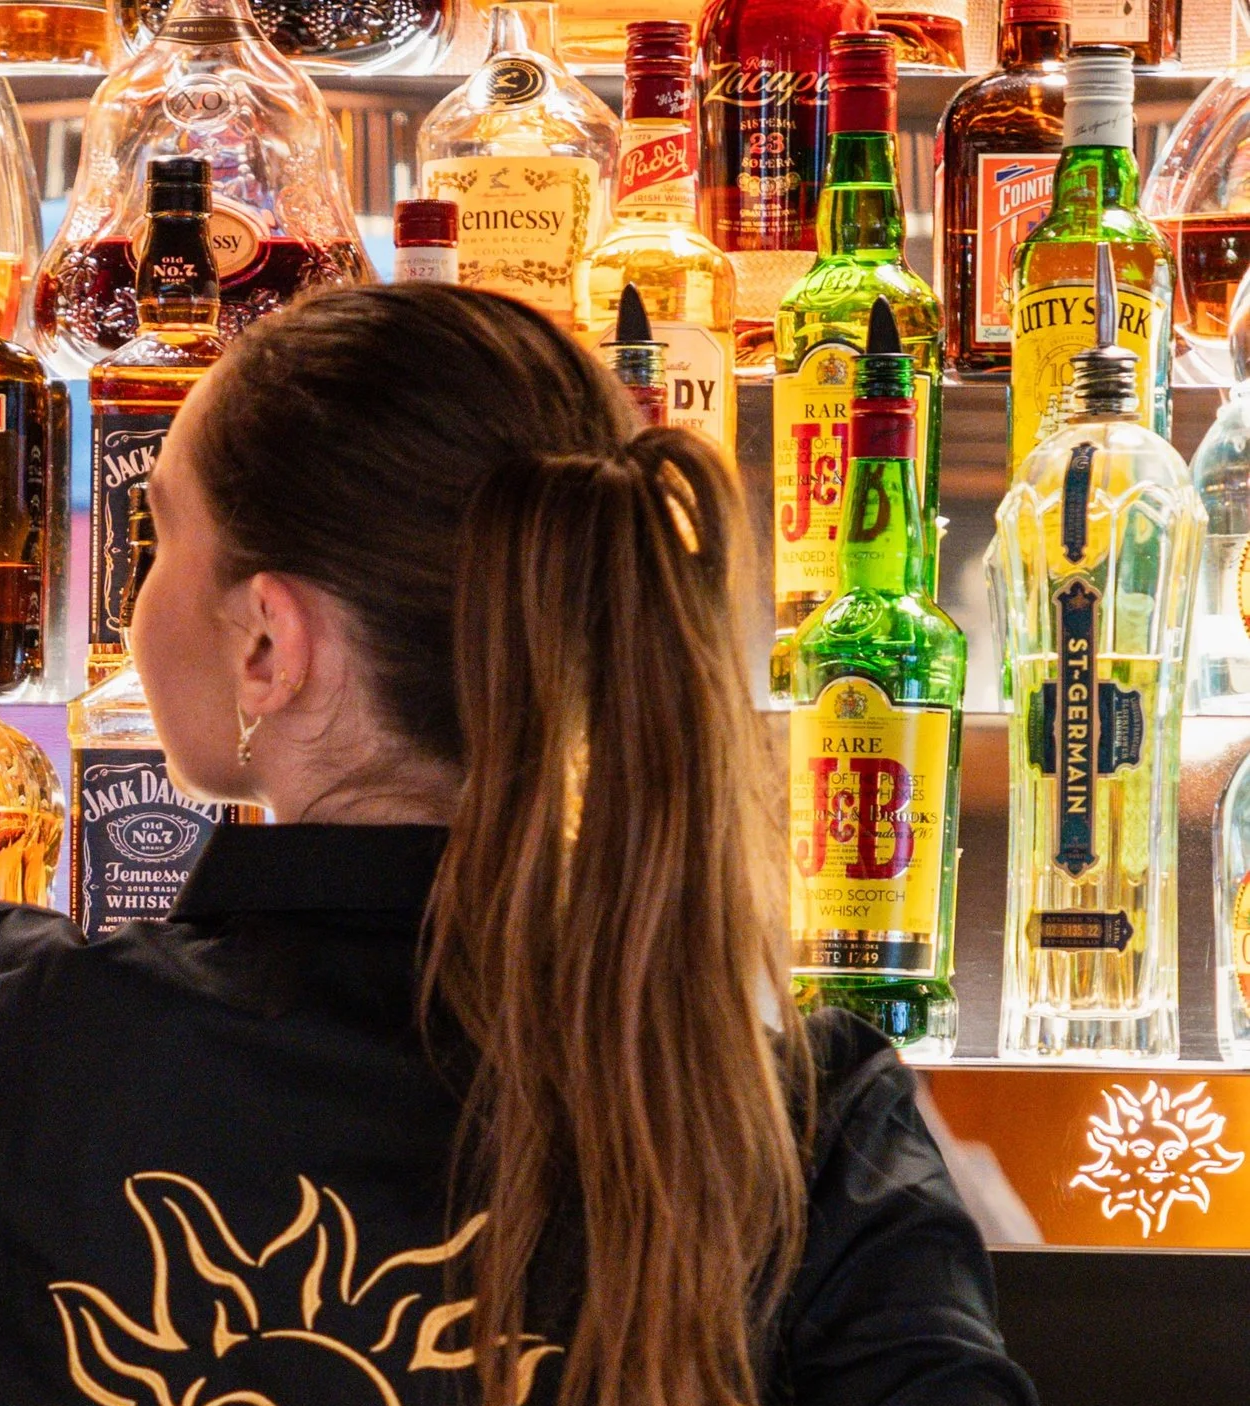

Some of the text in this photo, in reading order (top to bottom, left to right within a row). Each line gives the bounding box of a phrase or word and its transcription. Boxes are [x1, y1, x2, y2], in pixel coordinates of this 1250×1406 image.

[750, 132, 785, 154] 23
[622, 140, 689, 187] Paddy
[634, 194, 661, 203] IRISH
[457, 209, 566, 236] ennessy
[461, 237, 554, 245] ERY SPECIAL
[161, 256, 184, 264] Old
[1016, 296, 1152, 340] UTTY SRK
[103, 445, 156, 488] JACK
[822, 737, 884, 753] RARE
[82, 770, 228, 824] JACK DANLS
[792, 757, 914, 880] J&B
[869, 804, 938, 825] BROOKS
[142, 821, 163, 830] Old
[132, 831, 173, 844] No.7
[105, 895, 178, 909] WHISK
[847, 889, 906, 902] SCOTCH
[820, 904, 871, 917] WHISKY
[849, 951, 879, 964] 1749
